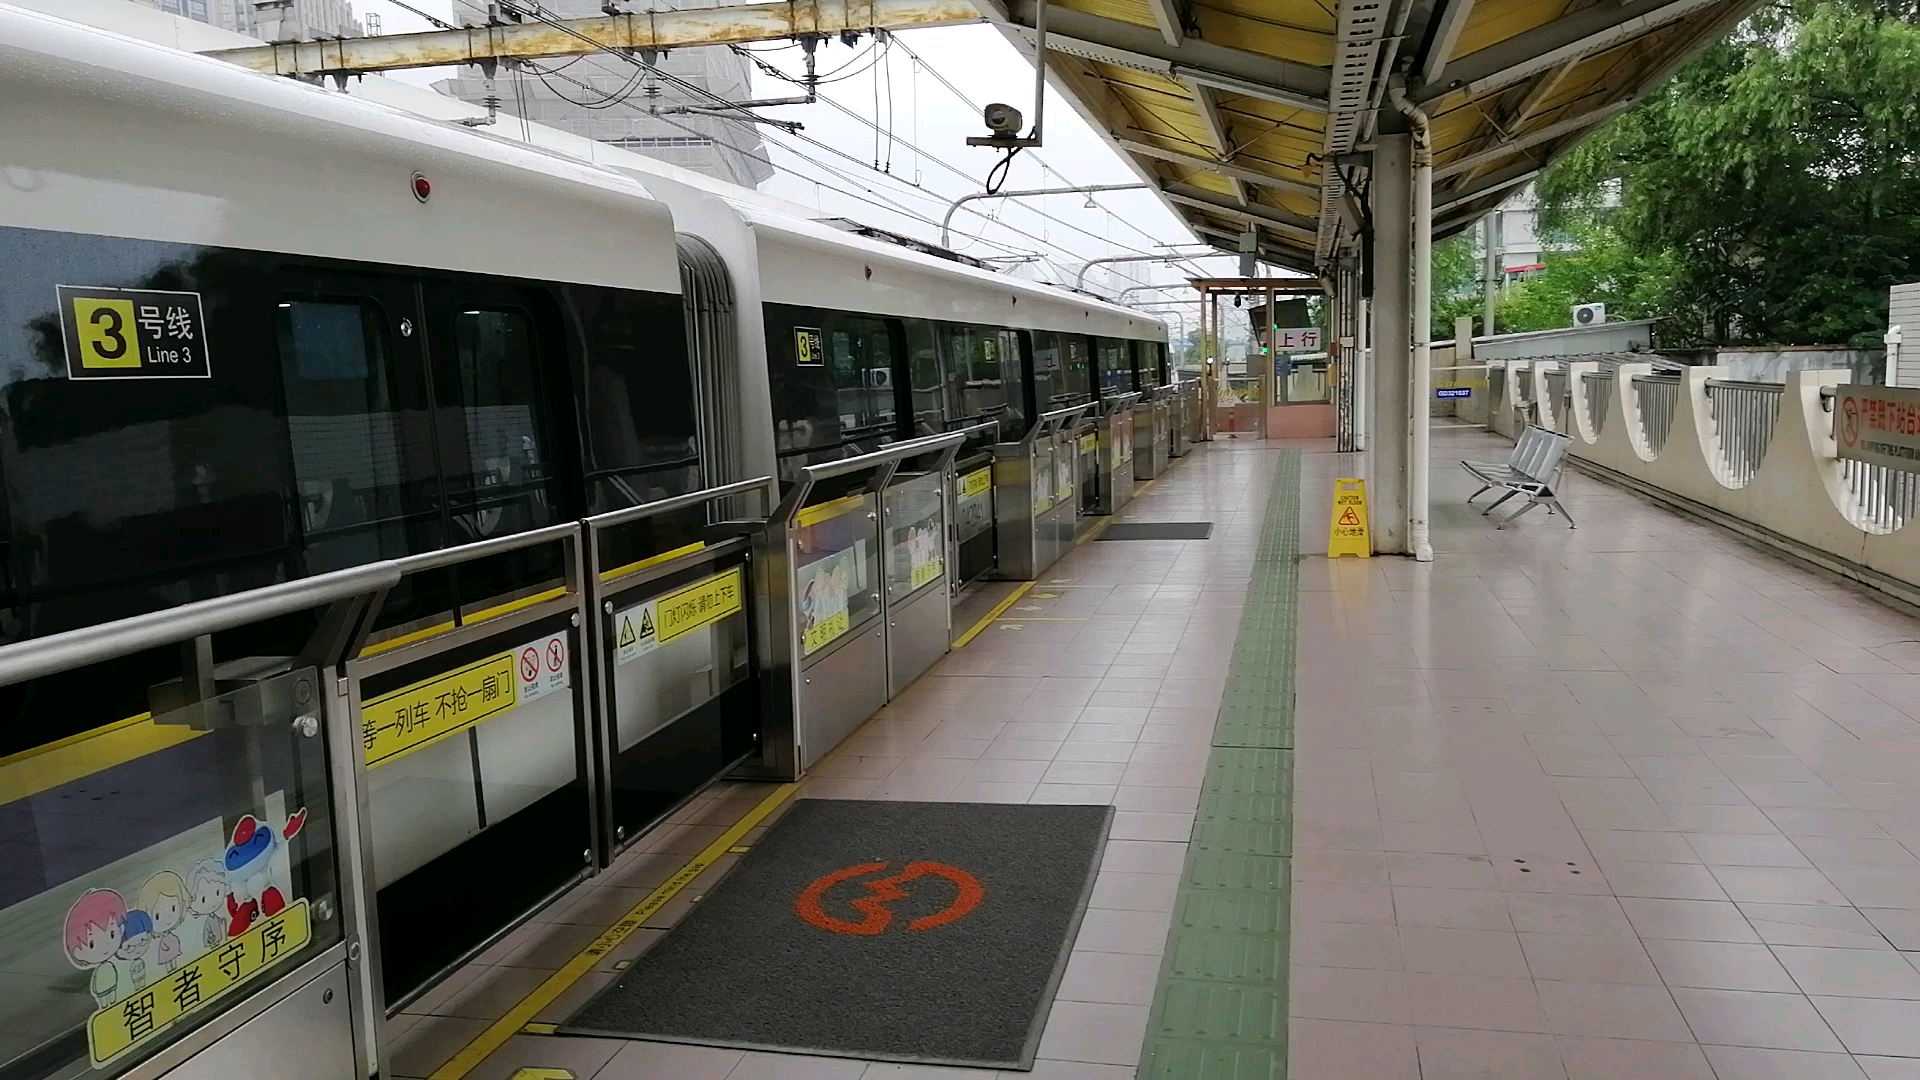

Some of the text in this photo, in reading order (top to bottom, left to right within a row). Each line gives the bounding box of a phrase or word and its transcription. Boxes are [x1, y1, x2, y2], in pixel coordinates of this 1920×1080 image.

[147, 346, 192, 363] Line 3
[1279, 331, 1318, 348] 上行
[435, 669, 510, 720] 不抢一扇门
[122, 918, 286, 1041] 智者守序
